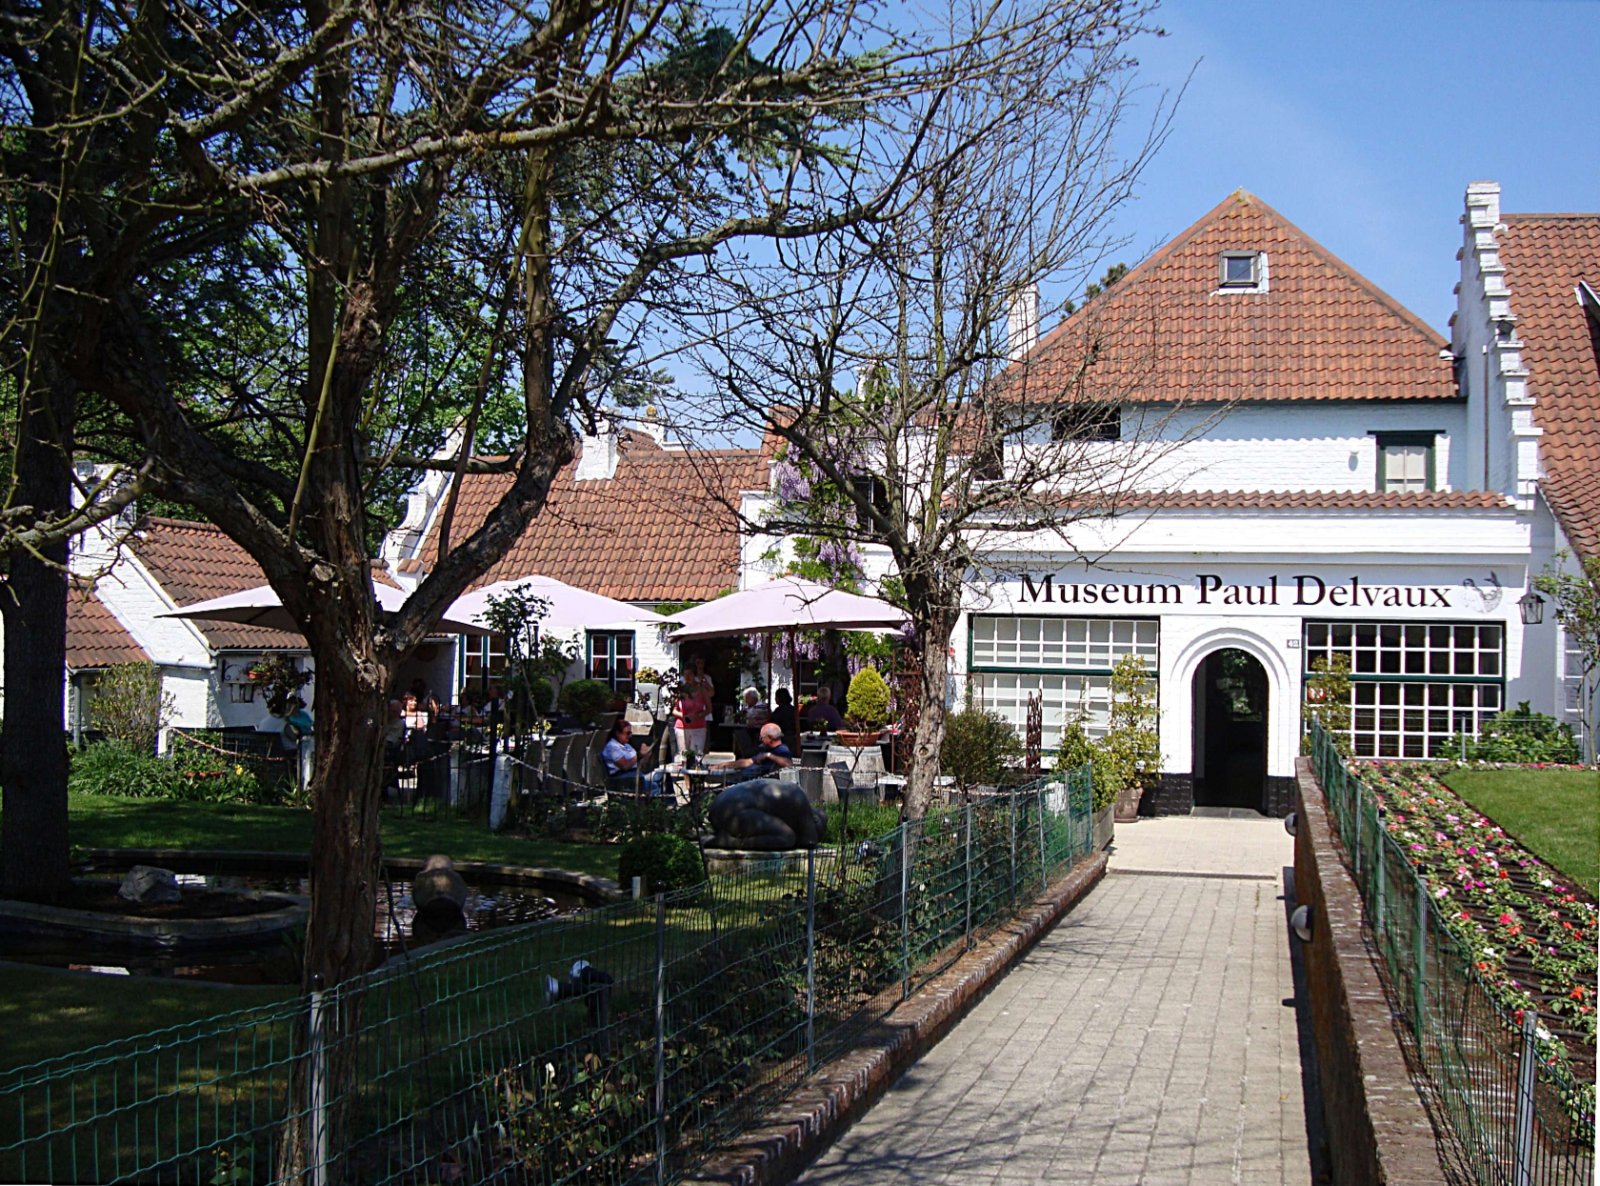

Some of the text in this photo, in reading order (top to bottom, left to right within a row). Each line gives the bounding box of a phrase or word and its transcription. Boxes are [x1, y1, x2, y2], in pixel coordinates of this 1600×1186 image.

[1017, 573, 1452, 608] Museum Paul Delvaux
